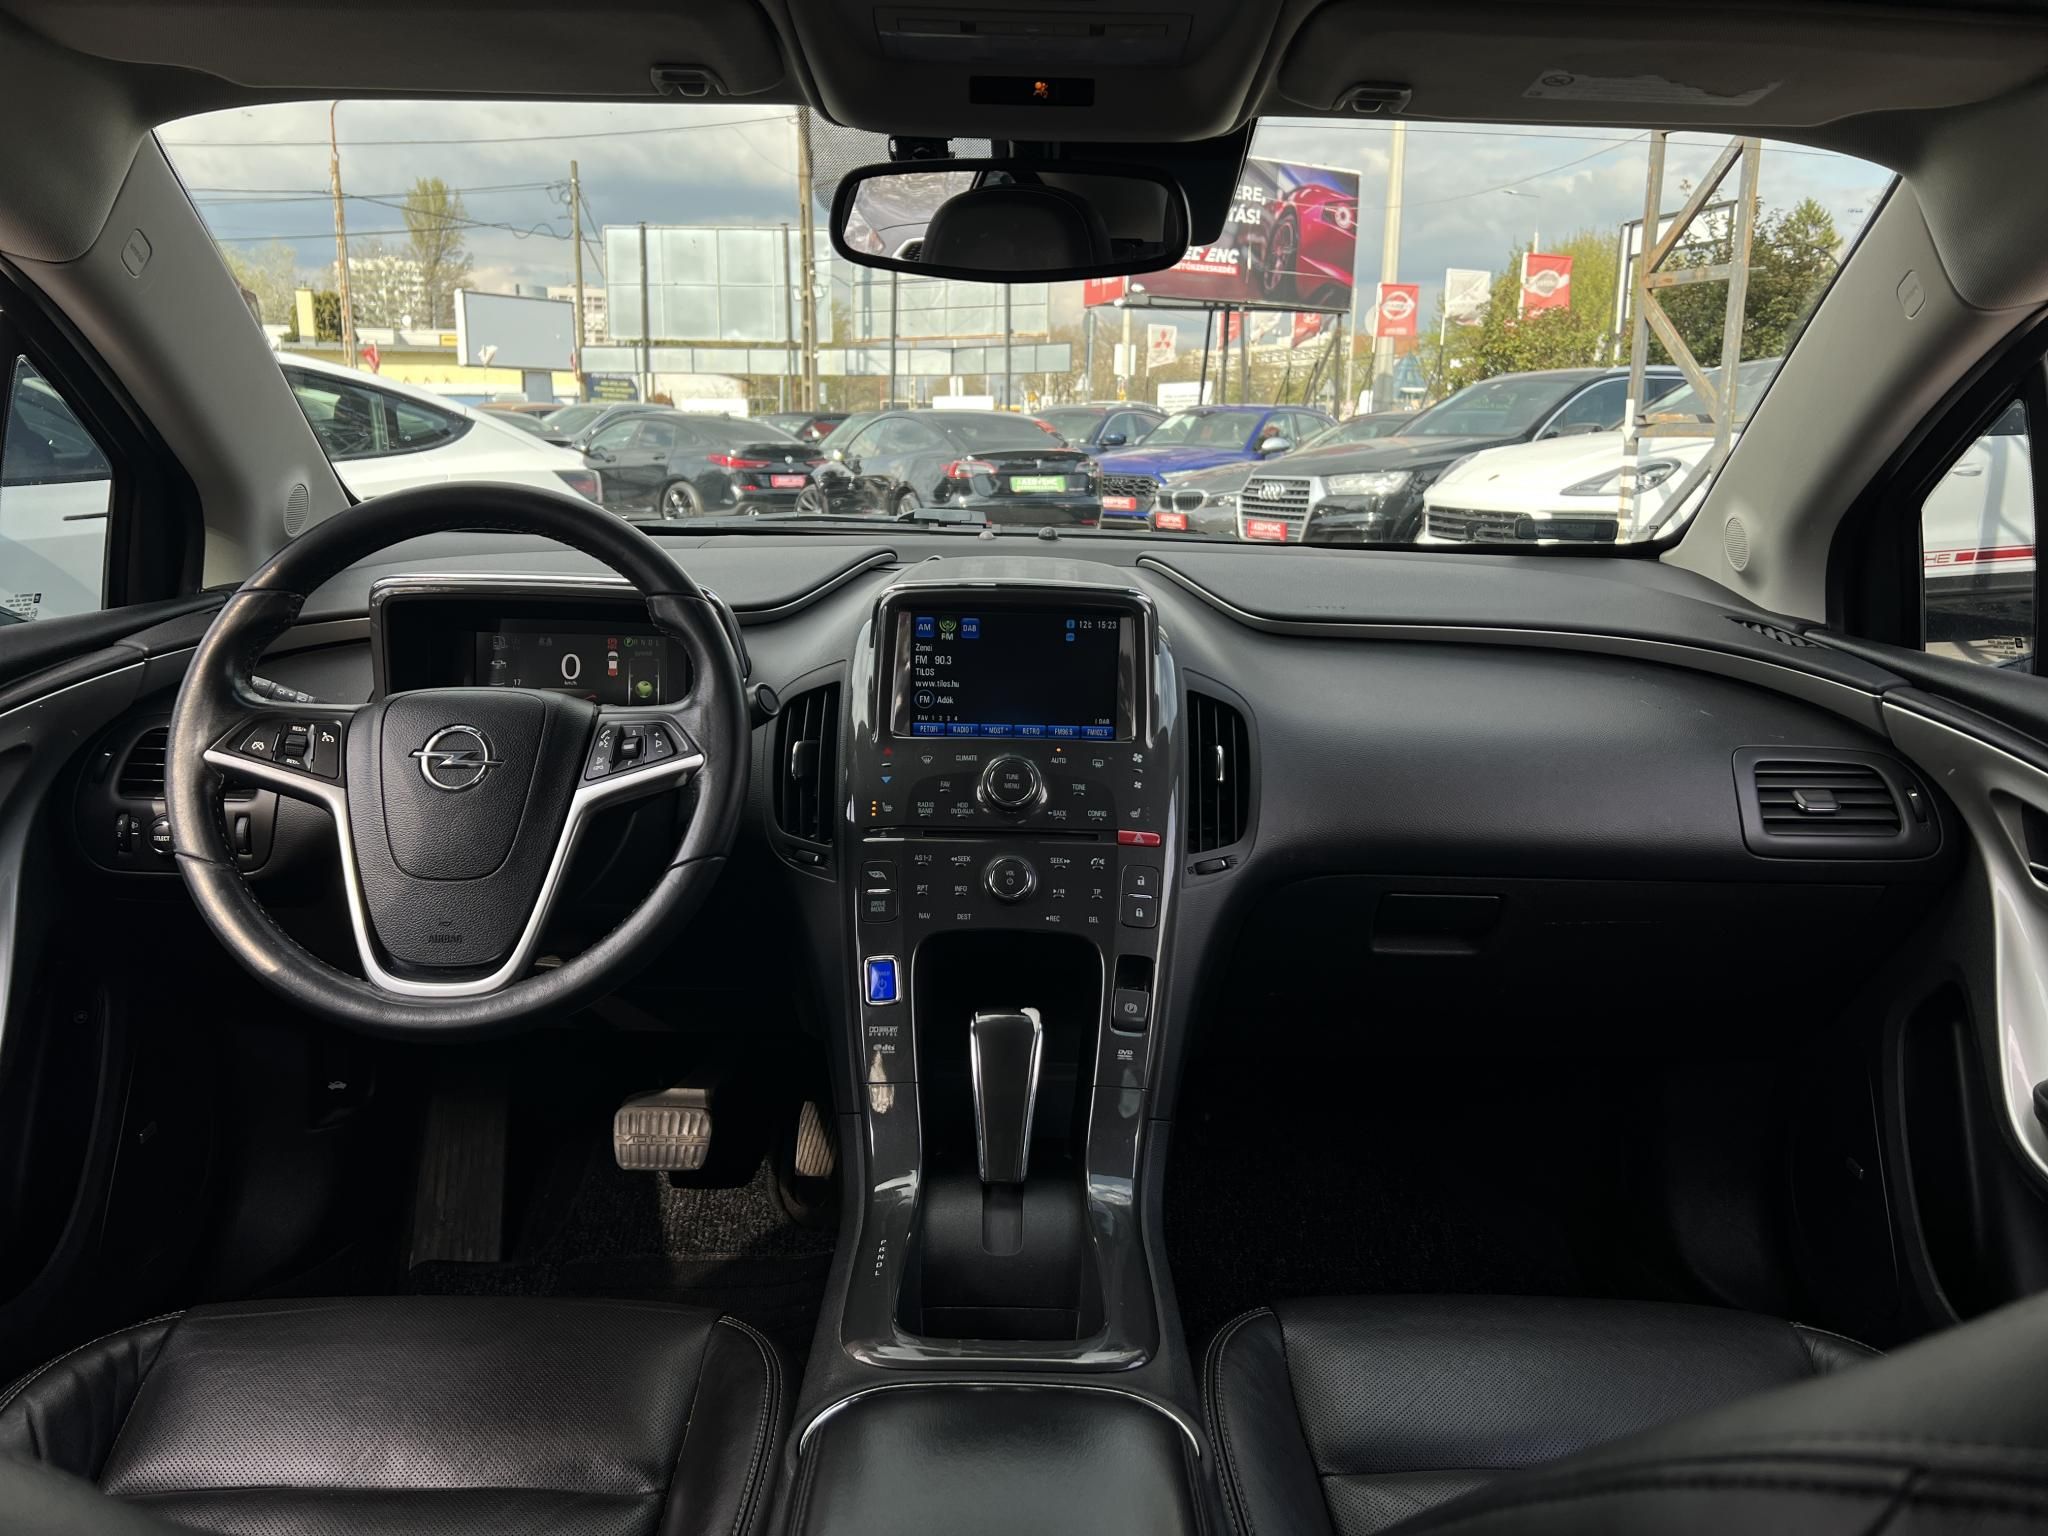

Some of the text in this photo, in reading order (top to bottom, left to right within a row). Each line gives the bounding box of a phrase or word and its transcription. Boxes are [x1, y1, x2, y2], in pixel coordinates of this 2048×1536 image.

[918, 624, 931, 632] AM
[962, 625, 976, 633] DAB
[941, 632, 954, 641] FM
[915, 654, 952, 666] FM 90.3
[561, 653, 581, 680] 0
[916, 668, 935, 676] TILOS
[513, 678, 521, 686] 17
[915, 680, 960, 688] www.tilos.hu
[919, 696, 930, 704] FM
[1022, 727, 1041, 735] RETRO
[1005, 773, 1020, 781] TUNE
[940, 780, 951, 788] FAV
[1004, 782, 1021, 790] MENU
[1072, 783, 1086, 791] TONE
[1051, 809, 1067, 817] BACK
[1088, 916, 1099, 924] DEL
[876, 1261, 883, 1269] D
